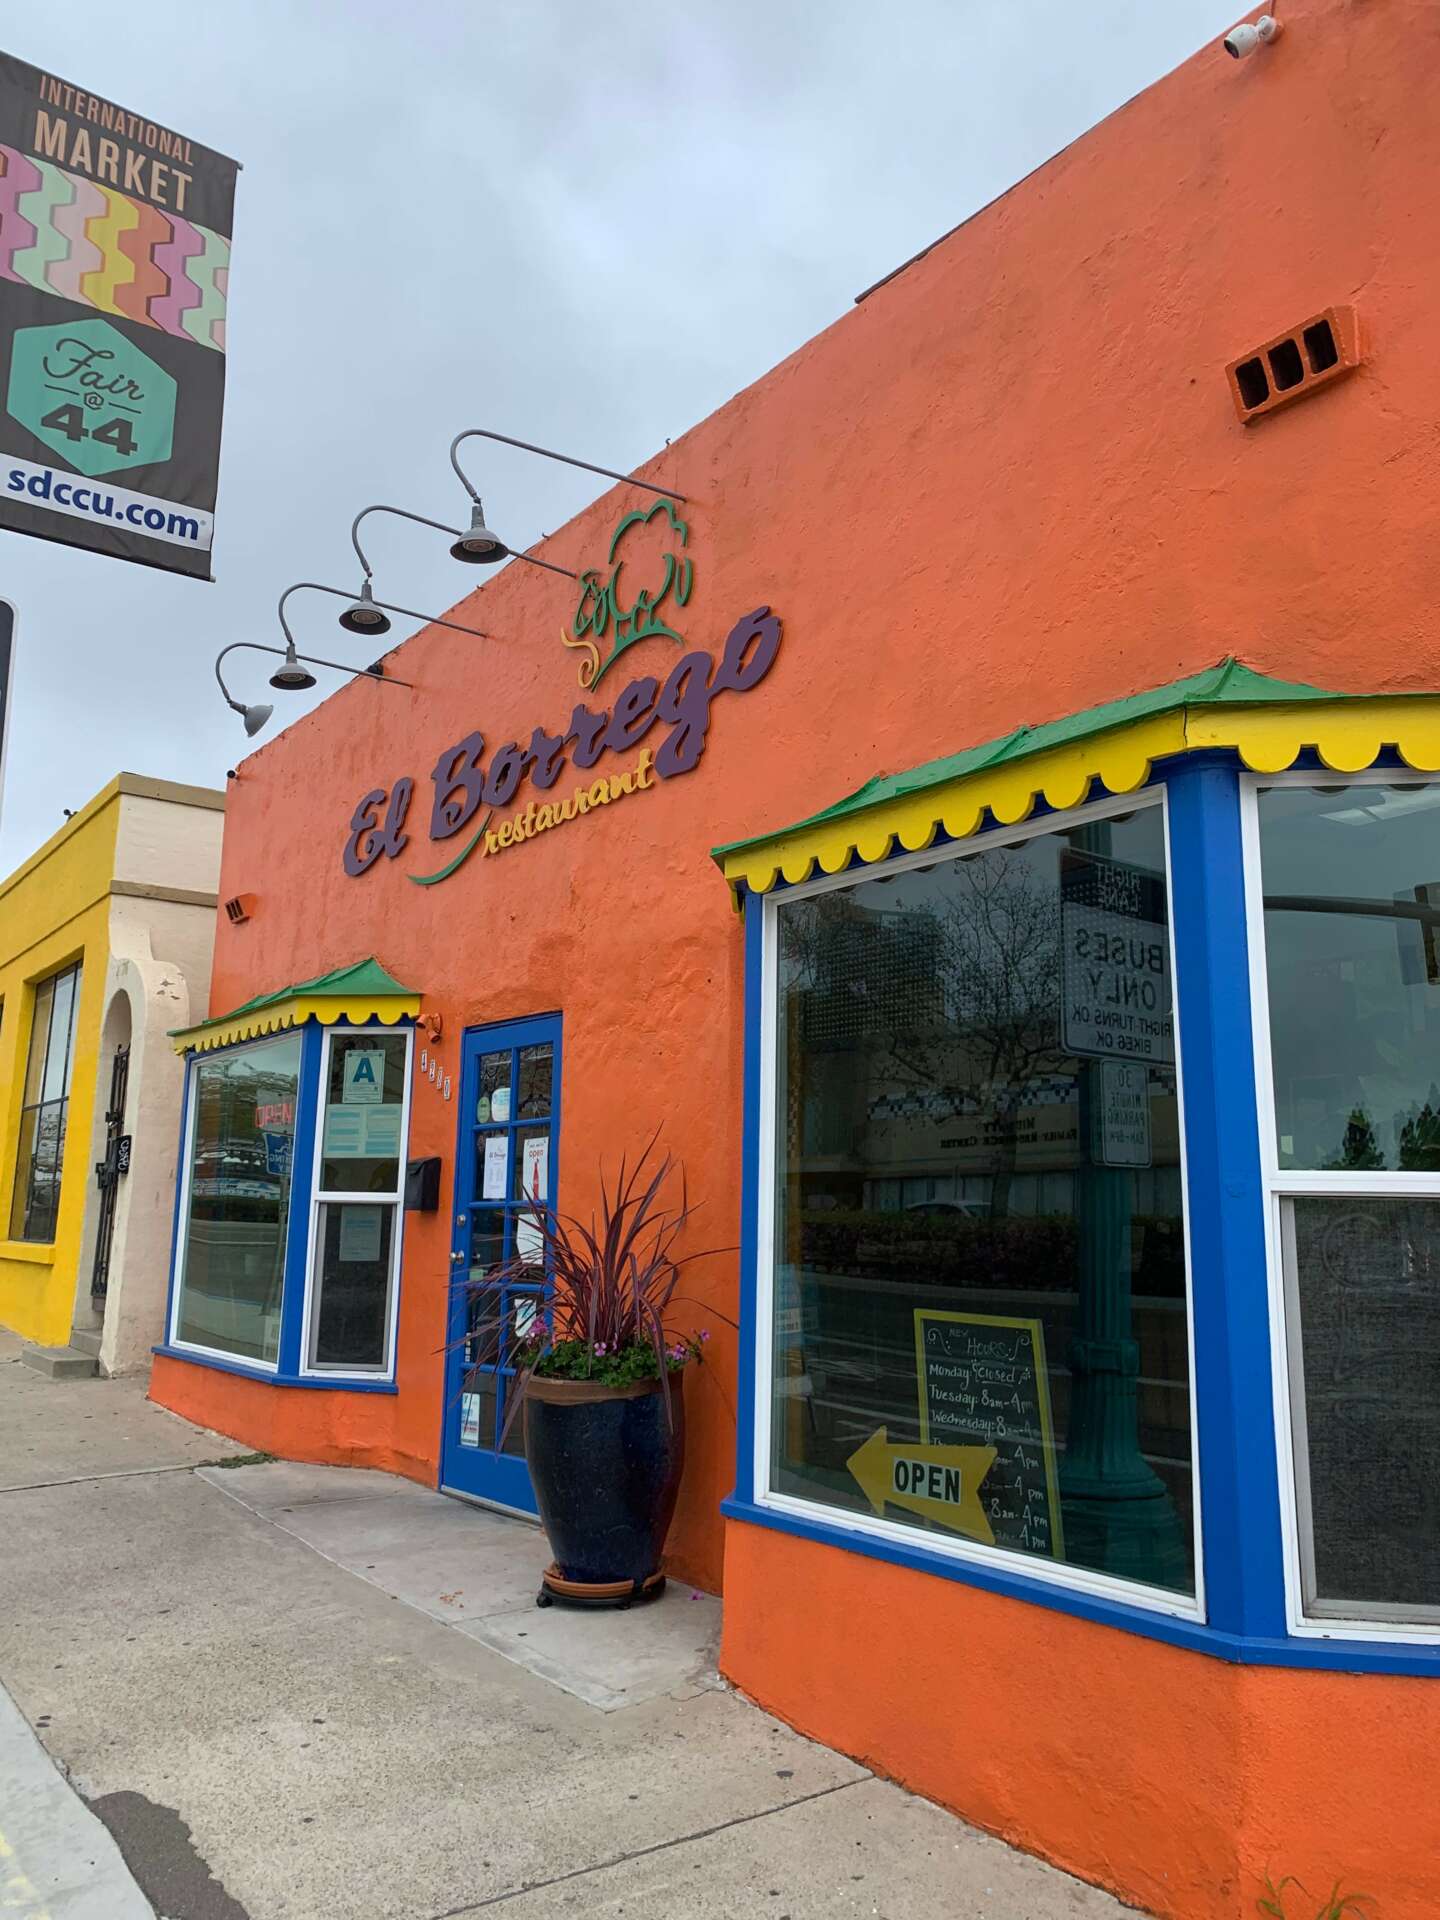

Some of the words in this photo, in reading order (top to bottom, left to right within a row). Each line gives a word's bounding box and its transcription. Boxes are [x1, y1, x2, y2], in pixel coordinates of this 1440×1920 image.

[39, 75, 194, 166] INTERNATIONAL
[34, 109, 193, 212] MARKET
[43, 338, 144, 400] Fair
[41, 403, 138, 456] 44
[343, 776, 412, 876] El
[430, 605, 784, 840] Borrego
[481, 748, 656, 857] restaurant
[352, 1057, 375, 1083] A
[894, 1459, 961, 1504] OPEN
